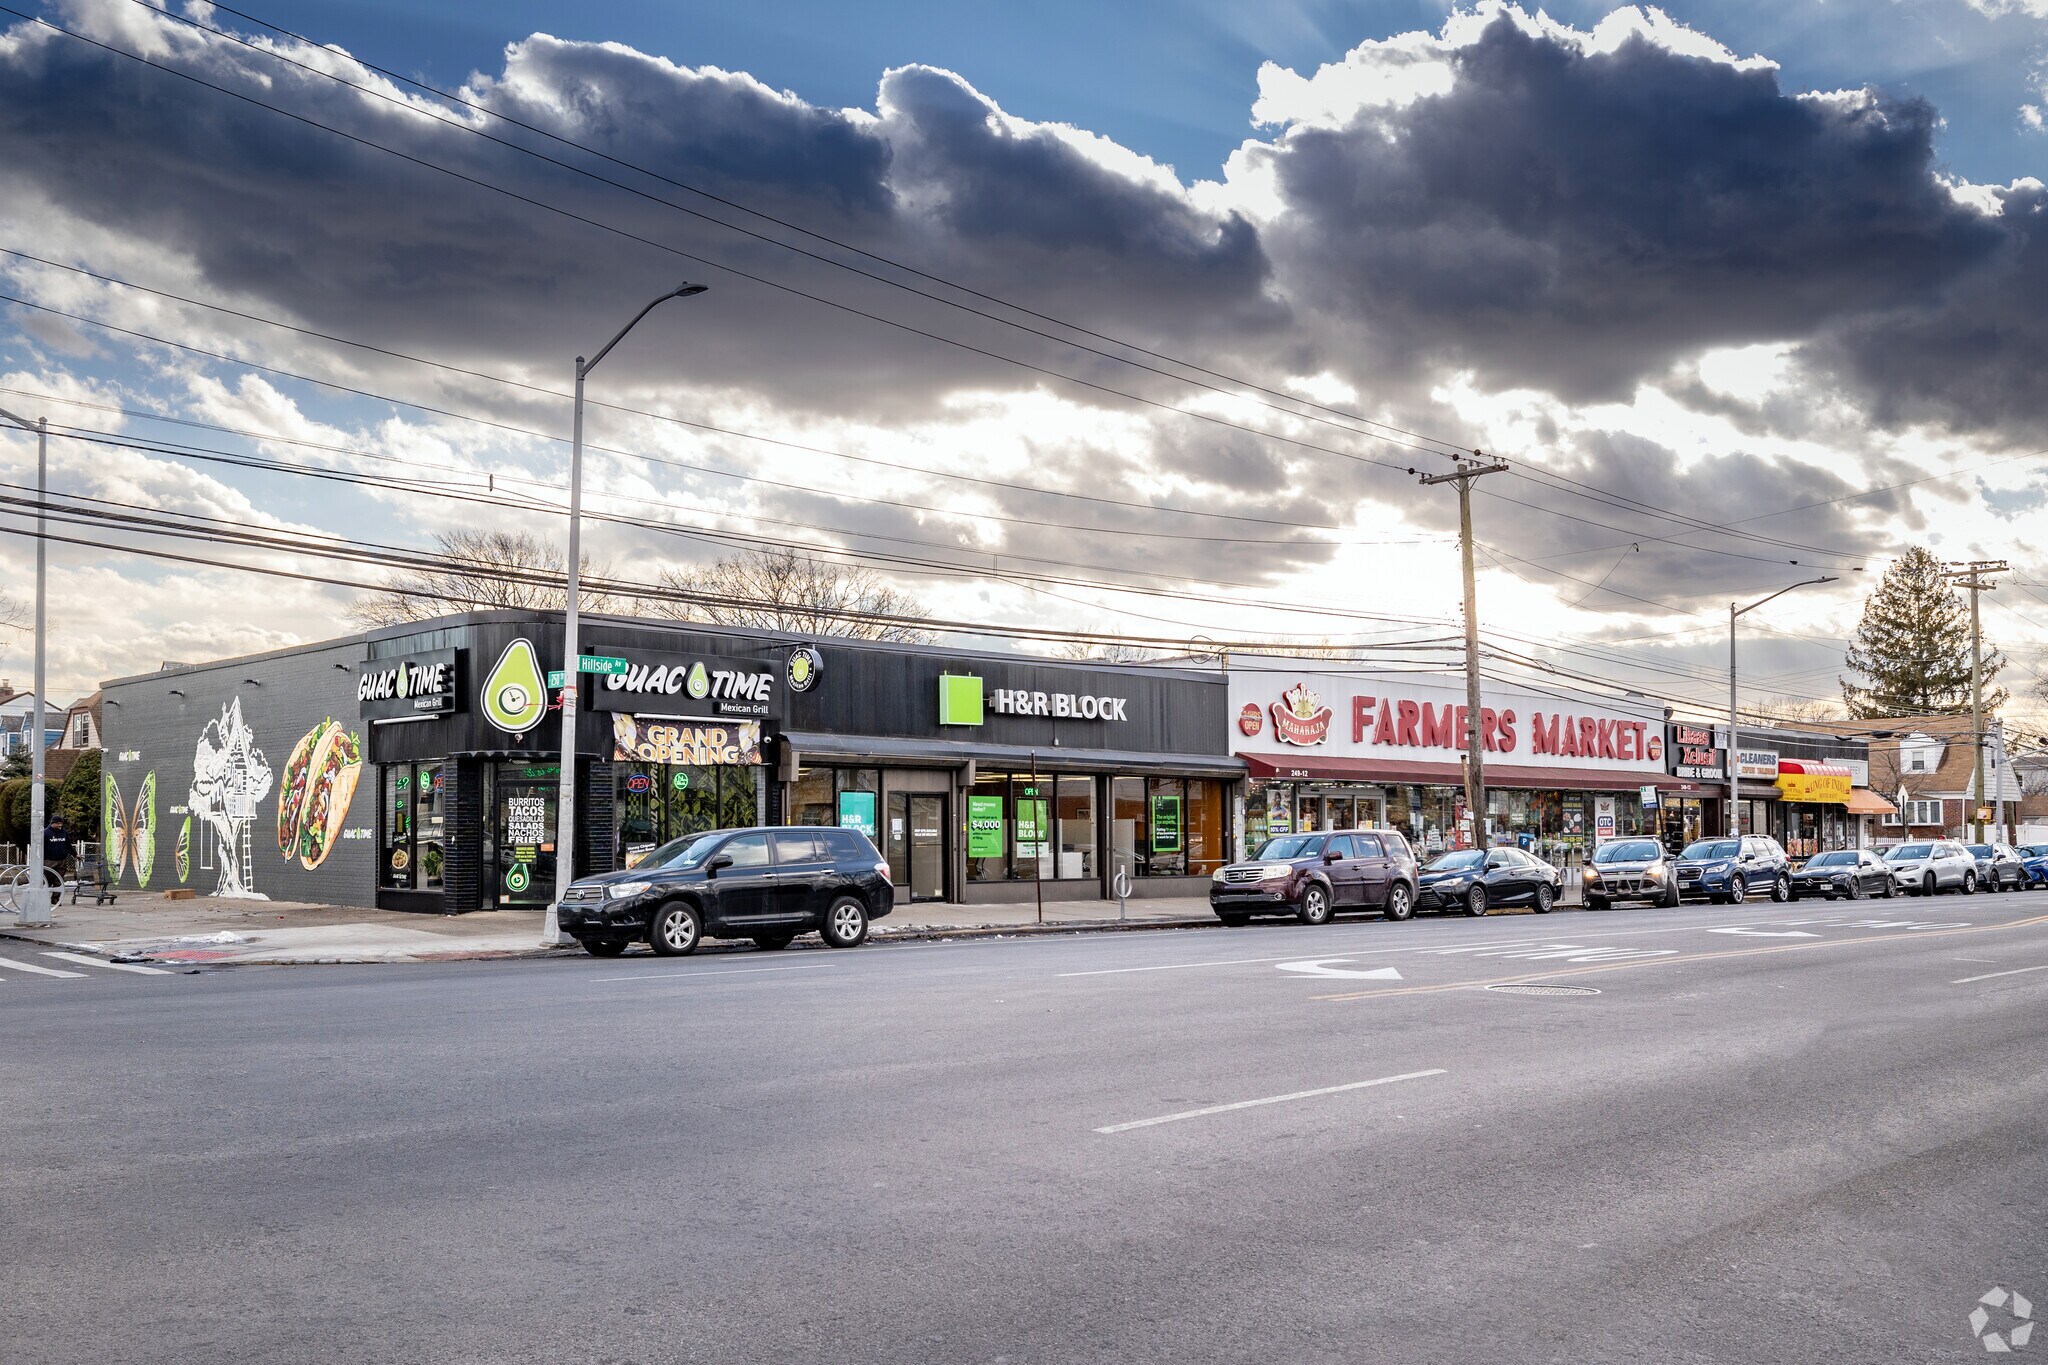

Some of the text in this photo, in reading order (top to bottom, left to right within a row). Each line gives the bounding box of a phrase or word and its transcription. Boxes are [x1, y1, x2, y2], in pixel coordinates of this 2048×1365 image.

[582, 658, 612, 671] Hillside
[358, 662, 444, 701] GUAC TIME
[607, 664, 774, 701] GUAC TIME
[414, 697, 441, 709] Mexican Grill
[721, 702, 769, 714] Mexican Grill
[995, 688, 1127, 721] H&R BLOCK
[1245, 720, 1260, 730] OPEN
[1281, 718, 1325, 735] MAHARAJA
[1352, 695, 1647, 760] FARMERS MARKET
[648, 725, 727, 747] GRAND
[1677, 725, 1709, 745] Libaas
[638, 743, 739, 765] OPENING
[1683, 747, 1716, 766] Xclusif
[1740, 753, 1776, 765] CLEANERS
[1291, 769, 1308, 777] 249-12
[1676, 766, 1722, 779] BRIDE & GROOM
[627, 778, 650, 789] OPEN
[508, 797, 544, 806] BURRITOS
[508, 806, 544, 816] TACOS
[842, 815, 861, 823] H&R
[972, 820, 1000, 830] $4,000
[1018, 821, 1035, 829] H&R
[1599, 817, 1612, 826] OTC
[508, 836, 544, 844] FRIES
